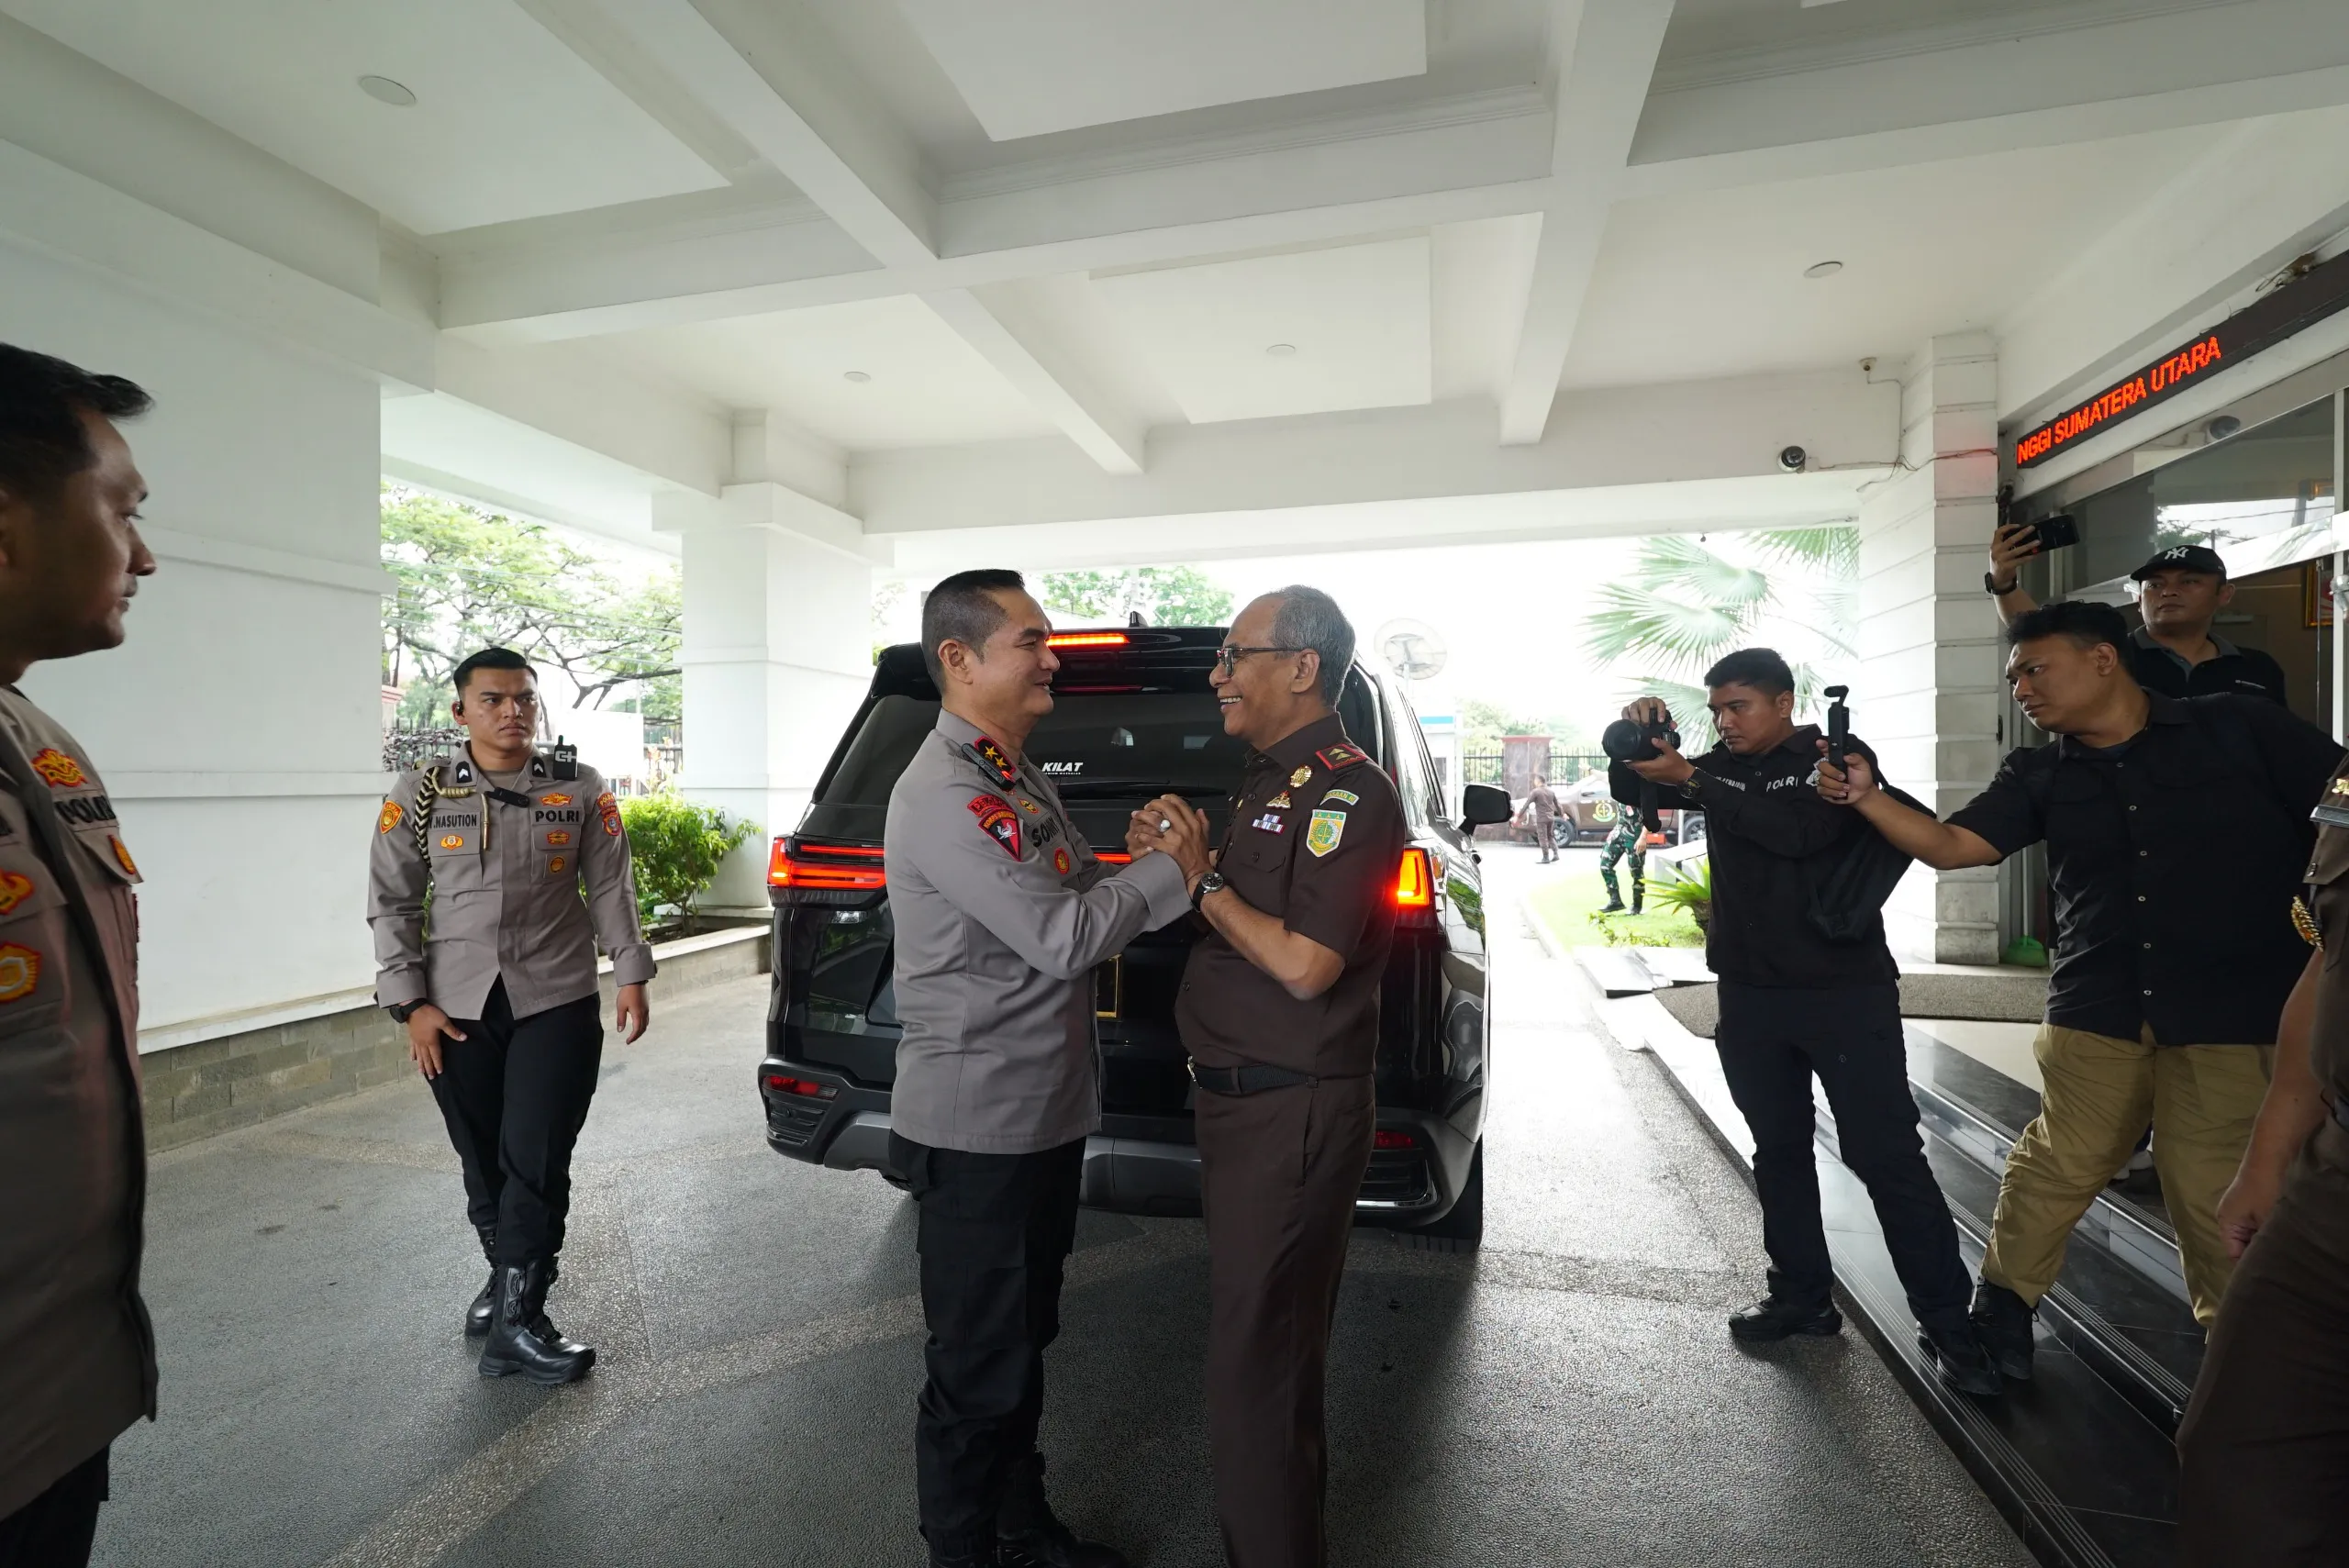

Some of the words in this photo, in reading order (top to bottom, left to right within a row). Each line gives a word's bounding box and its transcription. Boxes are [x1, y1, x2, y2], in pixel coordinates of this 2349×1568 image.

[2016, 428, 2052, 464] NGGI
[2054, 377, 2147, 445] SUMATERA
[2150, 336, 2221, 392] UTARA
[1041, 762, 1084, 772] KILAT
[1765, 775, 1798, 793] POLRI
[535, 809, 579, 823] POLRI
